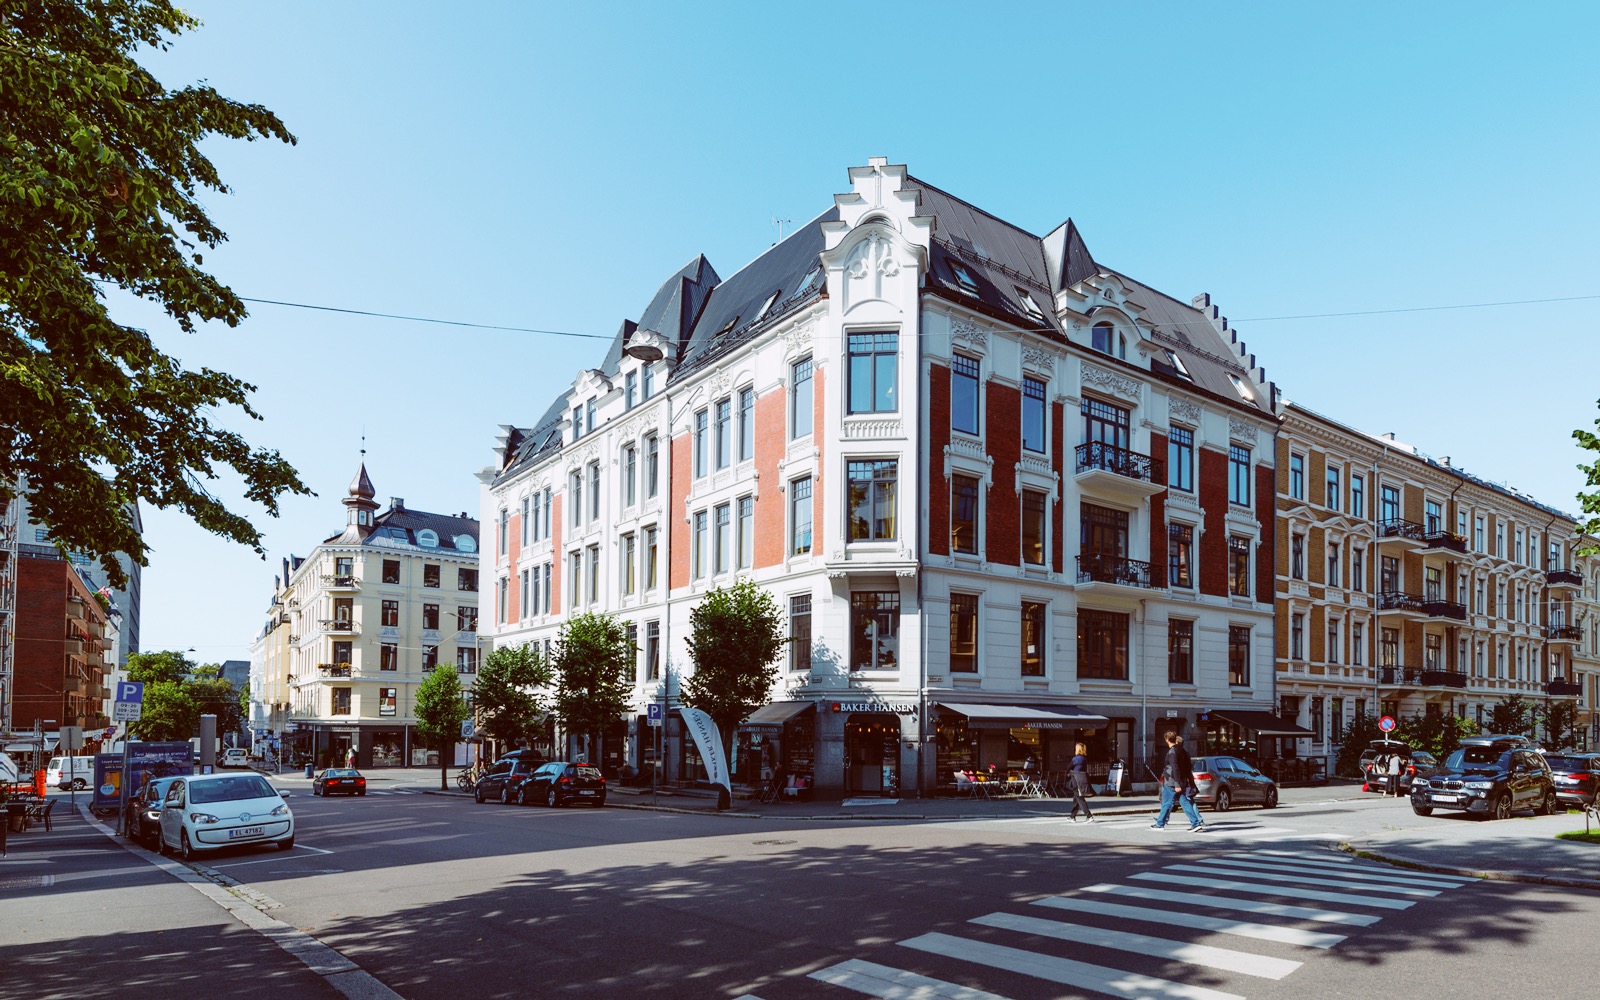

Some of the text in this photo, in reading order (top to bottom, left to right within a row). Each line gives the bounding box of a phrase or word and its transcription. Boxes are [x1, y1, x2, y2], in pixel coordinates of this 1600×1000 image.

[122, 684, 137, 700] P
[651, 706, 658, 717] P
[840, 703, 914, 712] BAKER HANSEN
